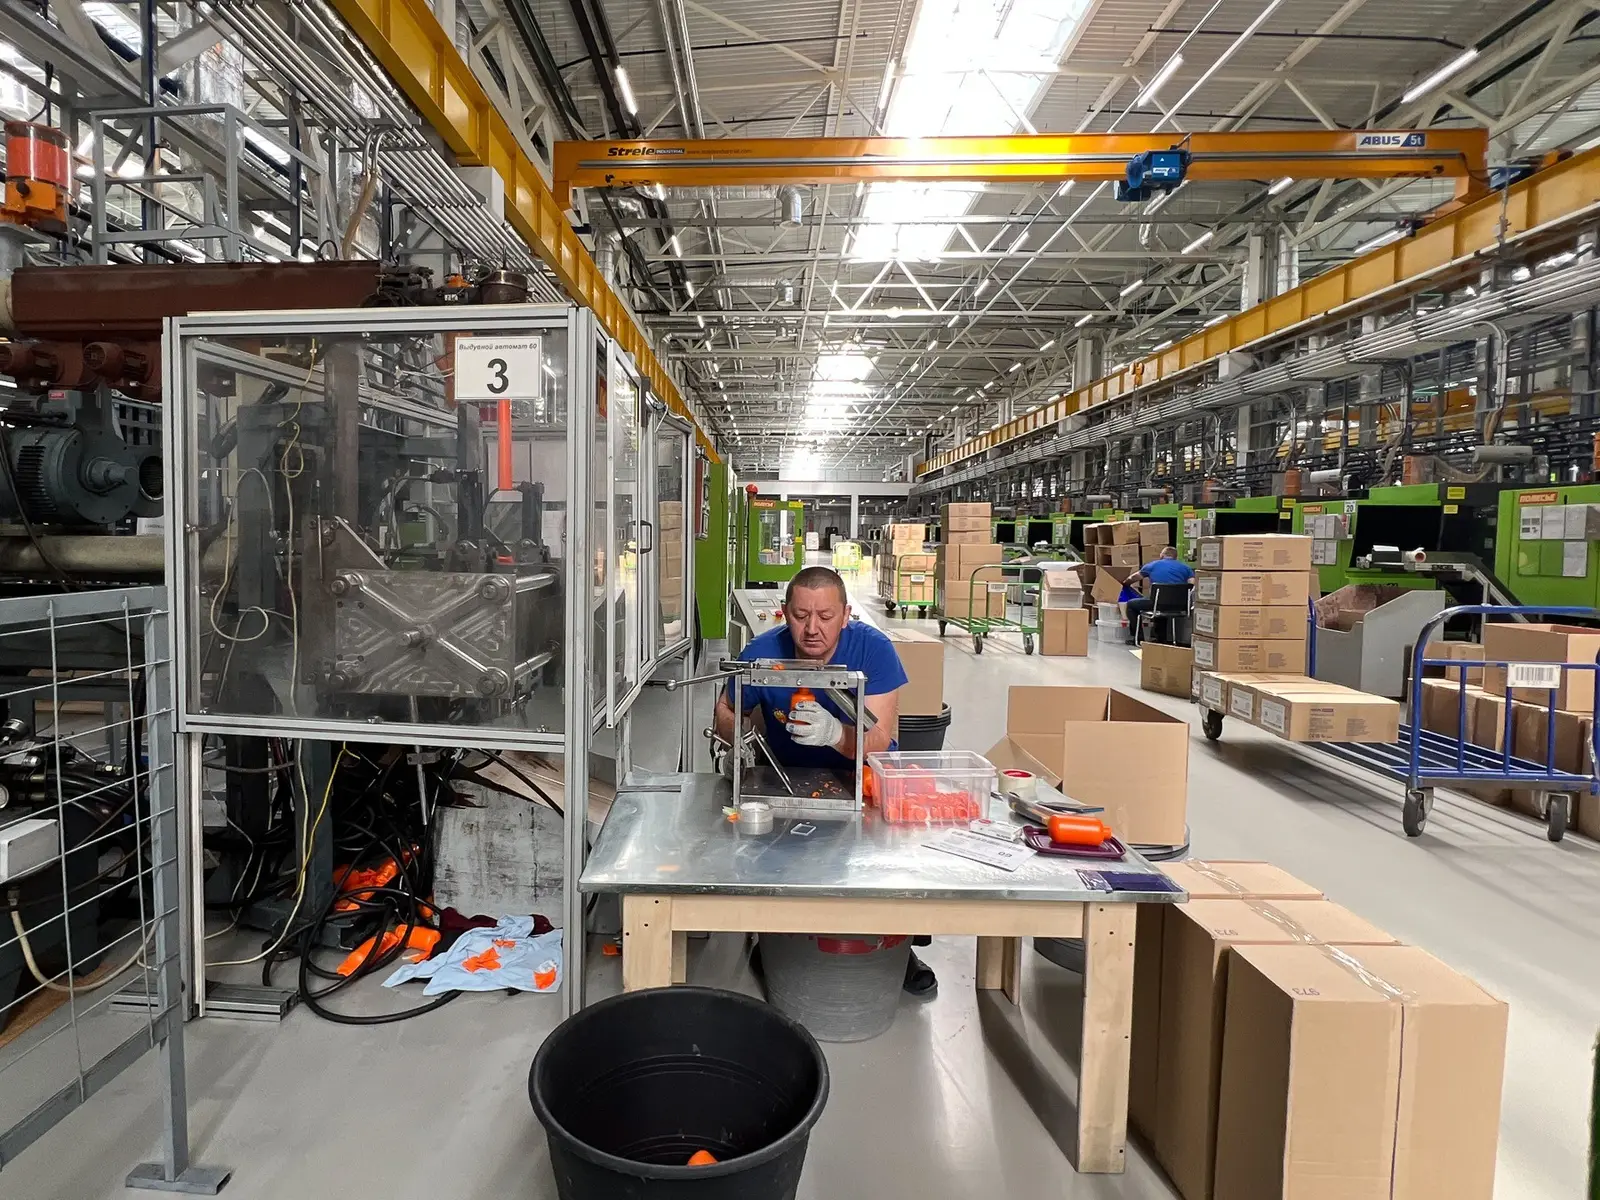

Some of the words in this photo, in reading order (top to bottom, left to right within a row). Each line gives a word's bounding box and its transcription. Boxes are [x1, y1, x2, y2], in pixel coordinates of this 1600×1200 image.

[1360, 136, 1401, 145] ABUS
[1410, 135, 1422, 145] 5t
[607, 147, 655, 156] Strele
[459, 343, 494, 351] Выдувной
[486, 358, 509, 394] 3
[1346, 504, 1354, 512] 20
